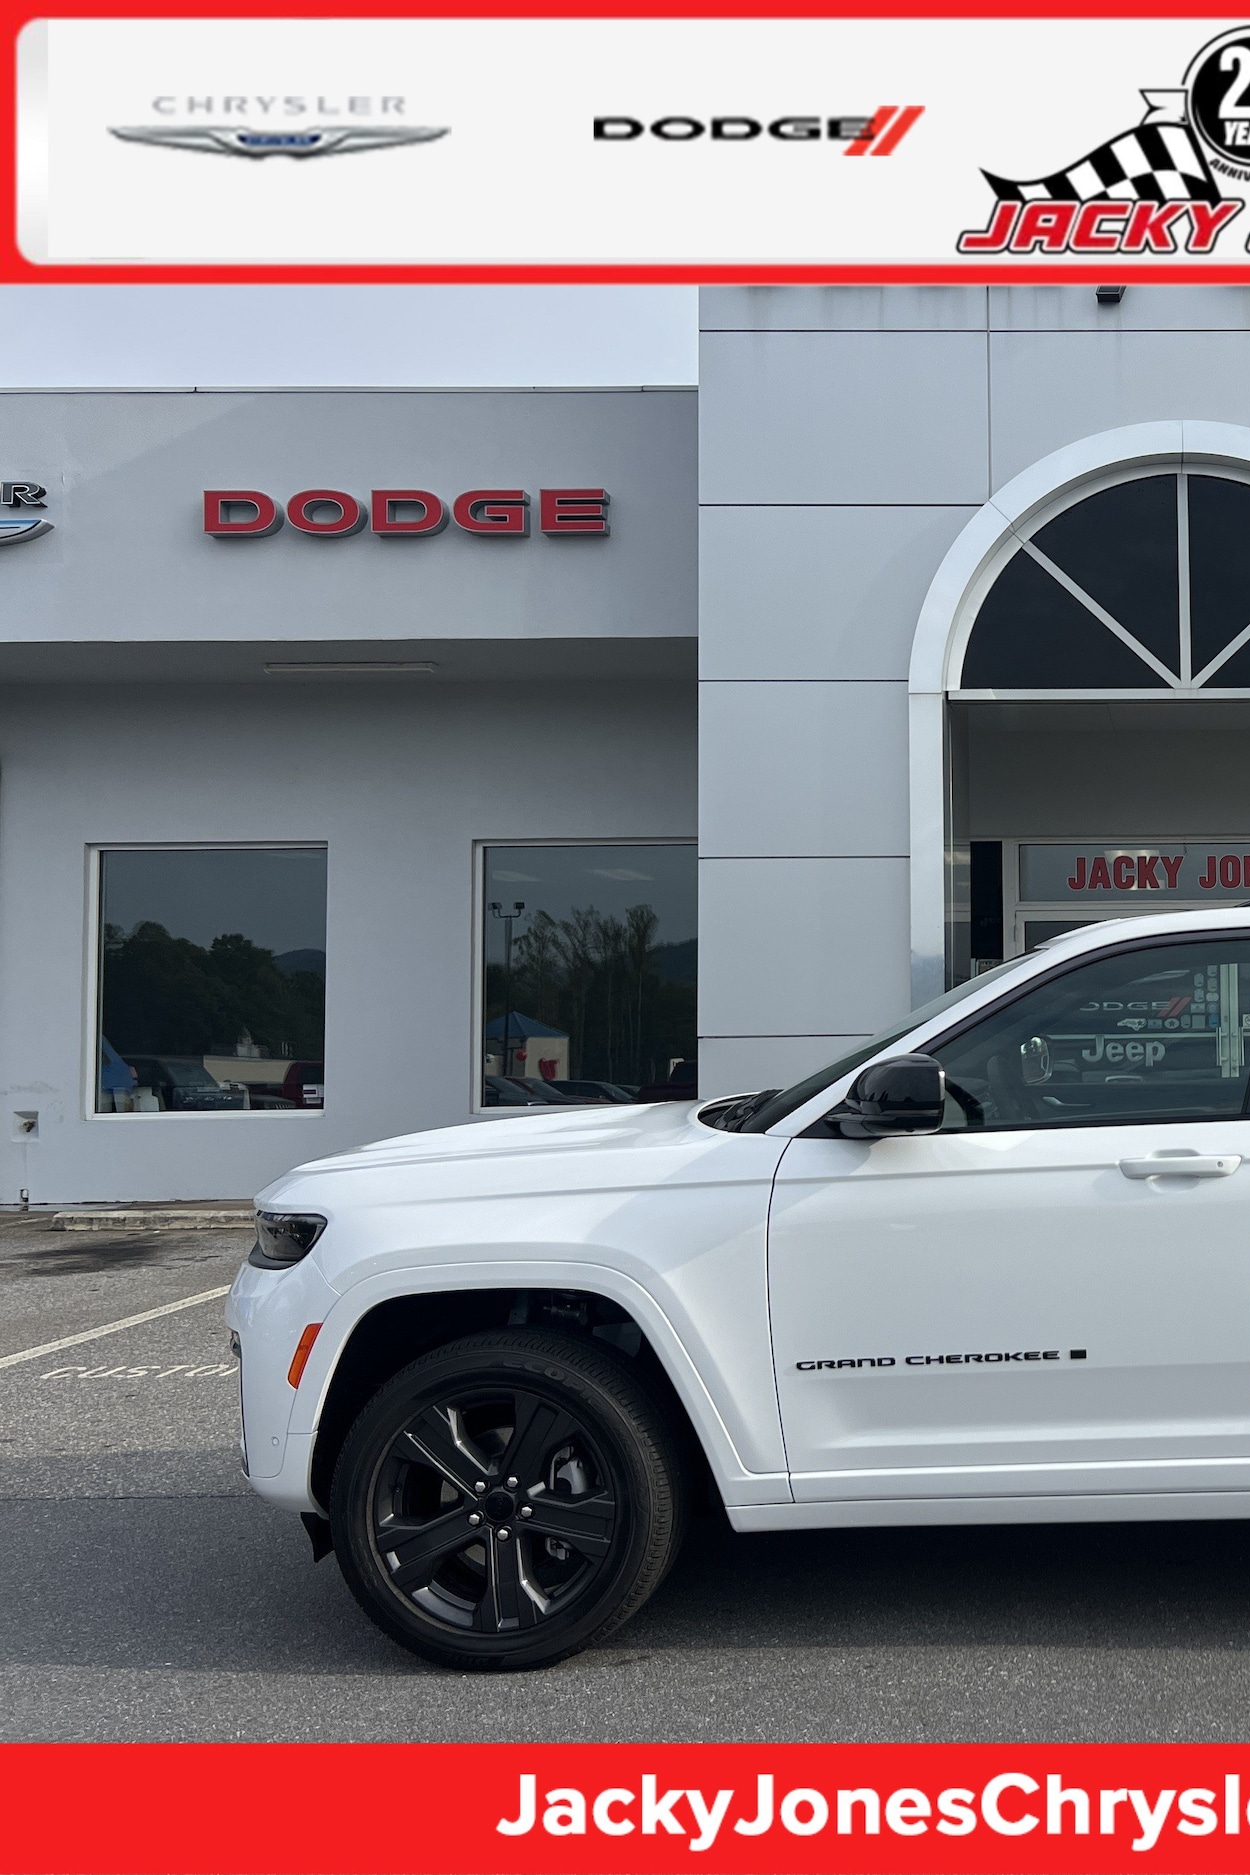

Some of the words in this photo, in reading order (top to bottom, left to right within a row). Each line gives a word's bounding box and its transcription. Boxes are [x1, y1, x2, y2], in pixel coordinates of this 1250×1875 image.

[203, 488, 610, 537] DODGE
[1067, 854, 1184, 891] JACKY
[1082, 1035, 1166, 1068] Jeep
[796, 1357, 896, 1371] GRAND
[905, 1350, 1061, 1366] CHEROKEE
